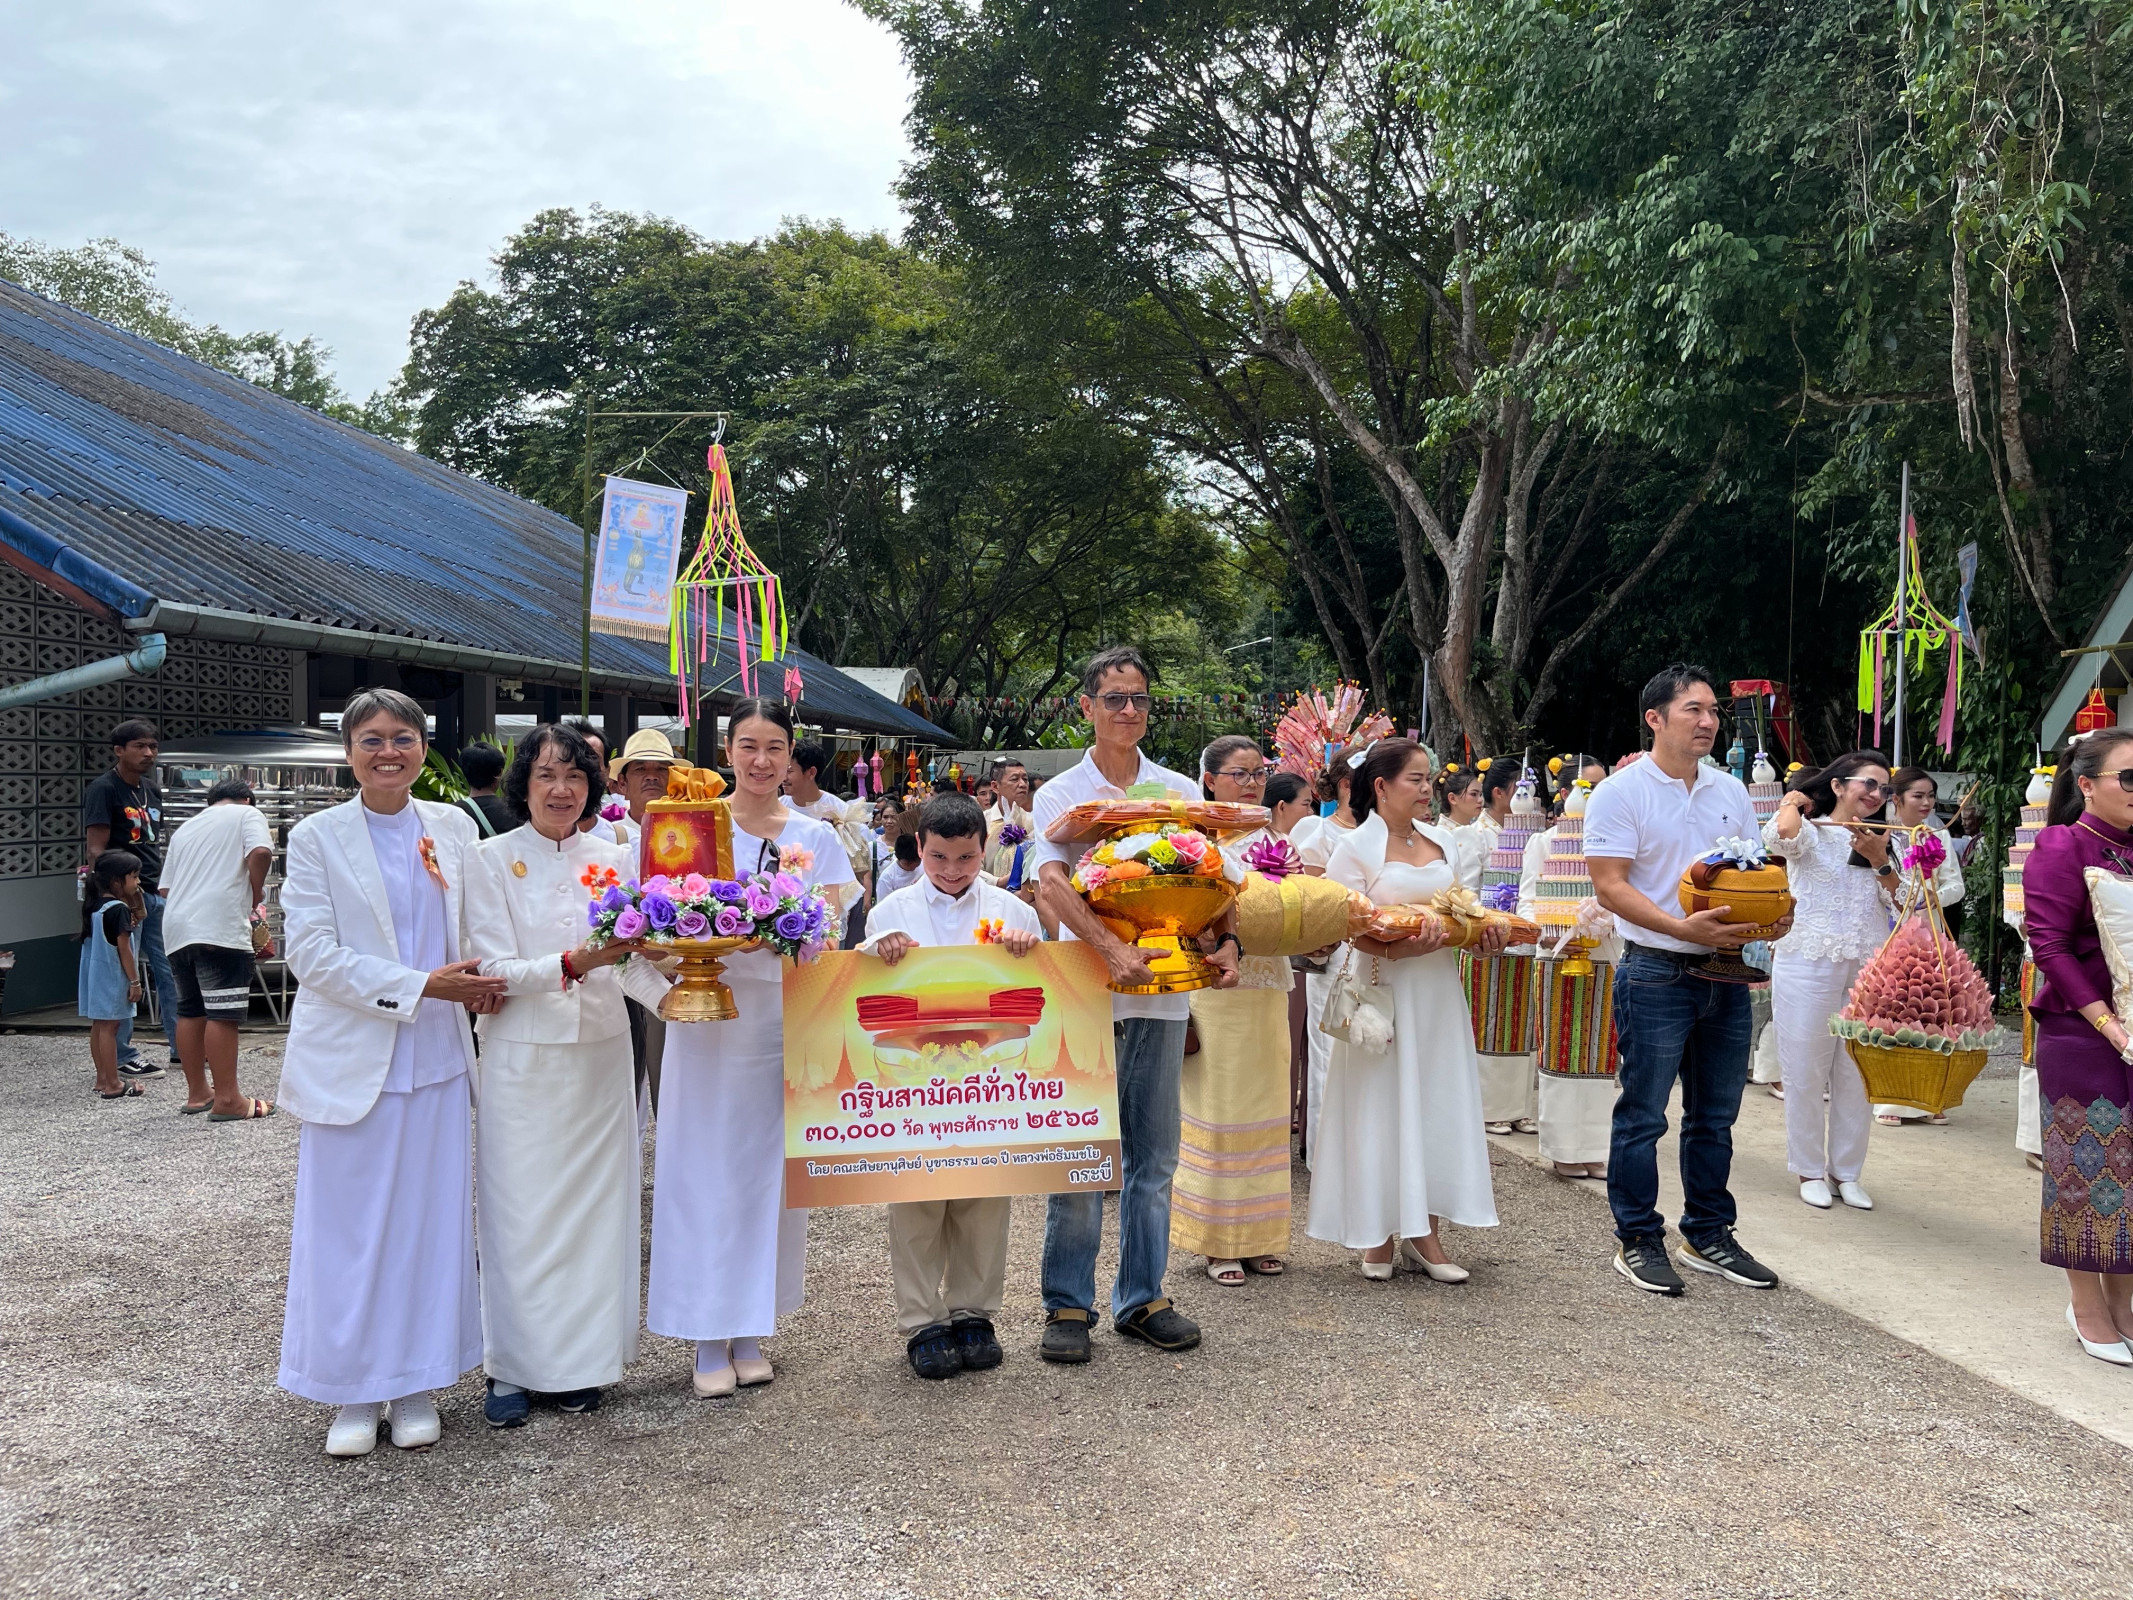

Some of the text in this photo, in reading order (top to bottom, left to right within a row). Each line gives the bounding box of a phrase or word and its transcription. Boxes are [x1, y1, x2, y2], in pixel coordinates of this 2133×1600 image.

[841, 1067, 1063, 1118] กฐินสามัคคีทั่วไทย
[805, 1108, 1099, 1143] ๓๐,๐๐๐ วัด พุทธศักราช ๒๕๖๘
[807, 1146, 1100, 1176] โดย คณะศิษยานุศิษย์ บูชาธรรม ๘๑ ปี หลวงพ่อธัมมชโย
[1070, 1156, 1112, 1182] กระบี่
